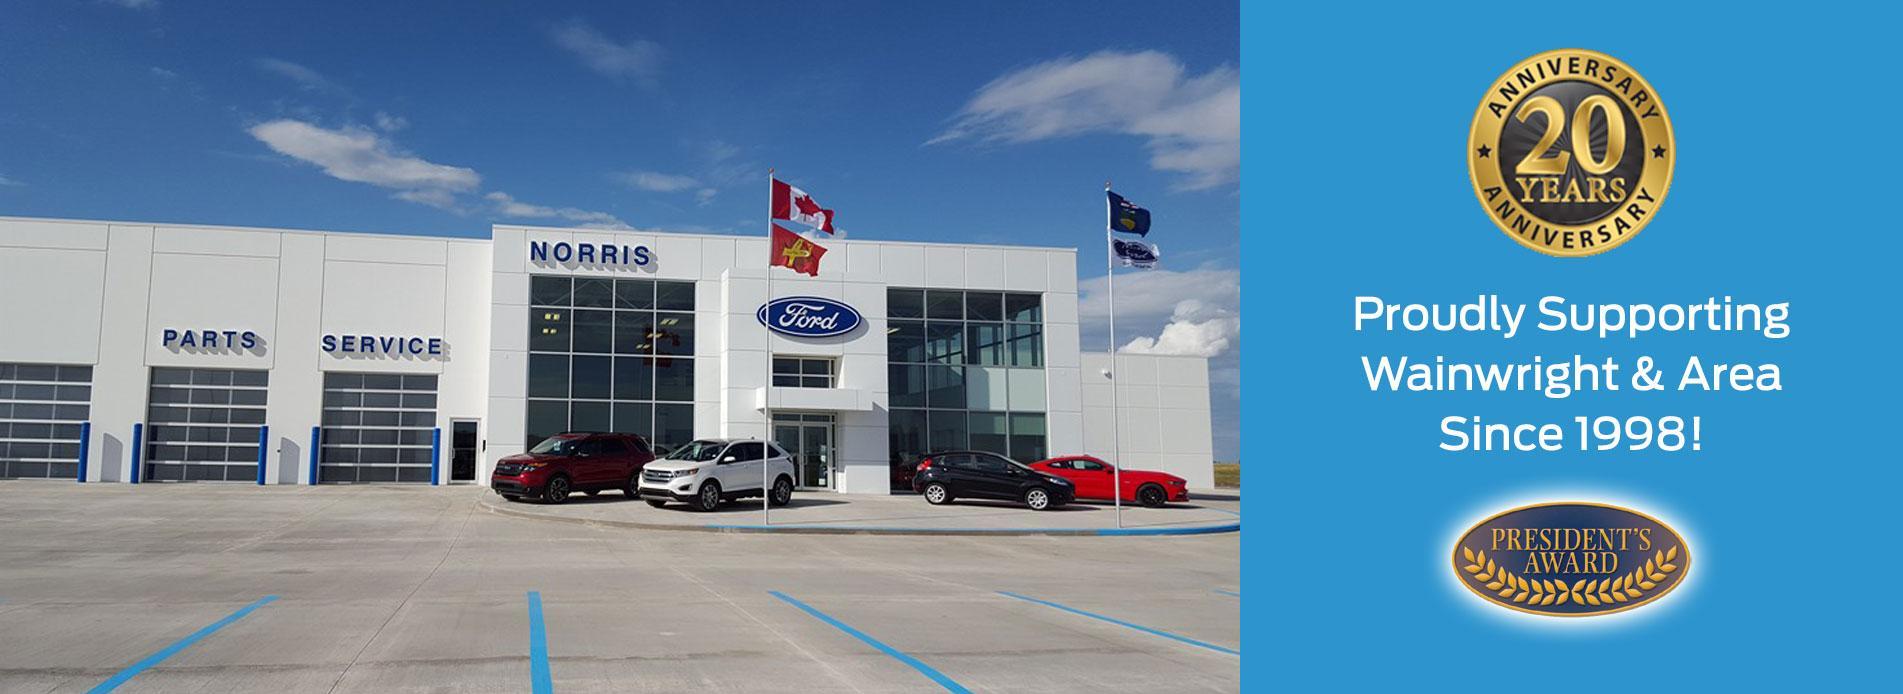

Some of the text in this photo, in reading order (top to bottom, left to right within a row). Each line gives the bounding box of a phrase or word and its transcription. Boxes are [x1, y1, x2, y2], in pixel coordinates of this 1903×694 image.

[530, 241, 650, 266] NORRIS
[779, 302, 839, 330] Ford
[163, 330, 257, 348] PARTS
[322, 335, 442, 354] SERVICE
